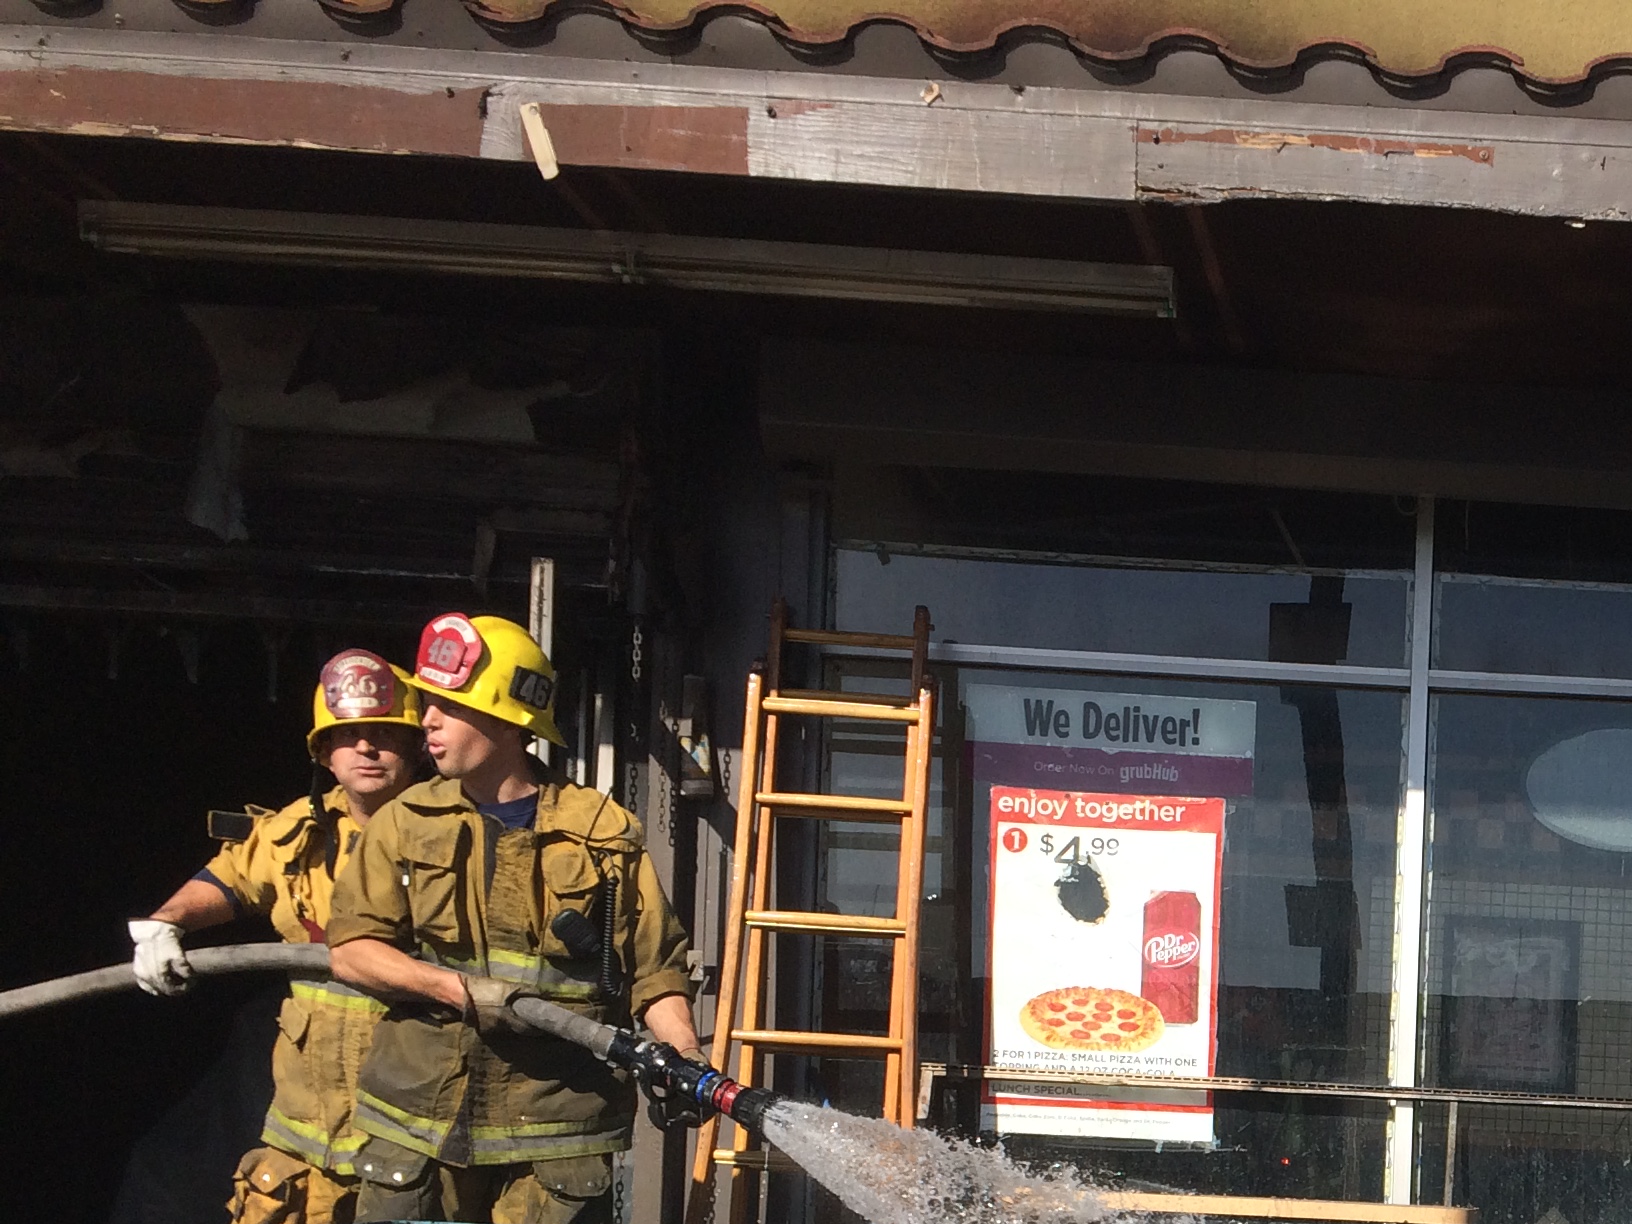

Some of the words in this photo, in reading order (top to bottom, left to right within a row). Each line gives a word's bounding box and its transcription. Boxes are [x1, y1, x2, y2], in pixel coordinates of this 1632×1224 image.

[519, 676, 549, 706] 46
[1023, 697, 1071, 738] We
[1082, 700, 1201, 747] Deliver!
[1033, 760, 1068, 773] Order
[1069, 763, 1095, 776] Now
[1097, 764, 1115, 776] On
[1119, 762, 1179, 783] grubHub
[997, 794, 1068, 820] enjoy
[1074, 797, 1186, 824] together
[1010, 830, 1022, 850] 1
[1150, 936, 1196, 964] Pepper
[1163, 933, 1184, 949] Dr
[1002, 1050, 1025, 1060] FOR
[1071, 1053, 1107, 1063] SMALL
[1109, 1055, 1141, 1065] PIZZA
[1144, 1057, 1172, 1067] WITH
[1174, 1058, 1198, 1068] ONE
[991, 1083, 1032, 1094] LUNCH
[1033, 1085, 1081, 1097] SPECIAL
